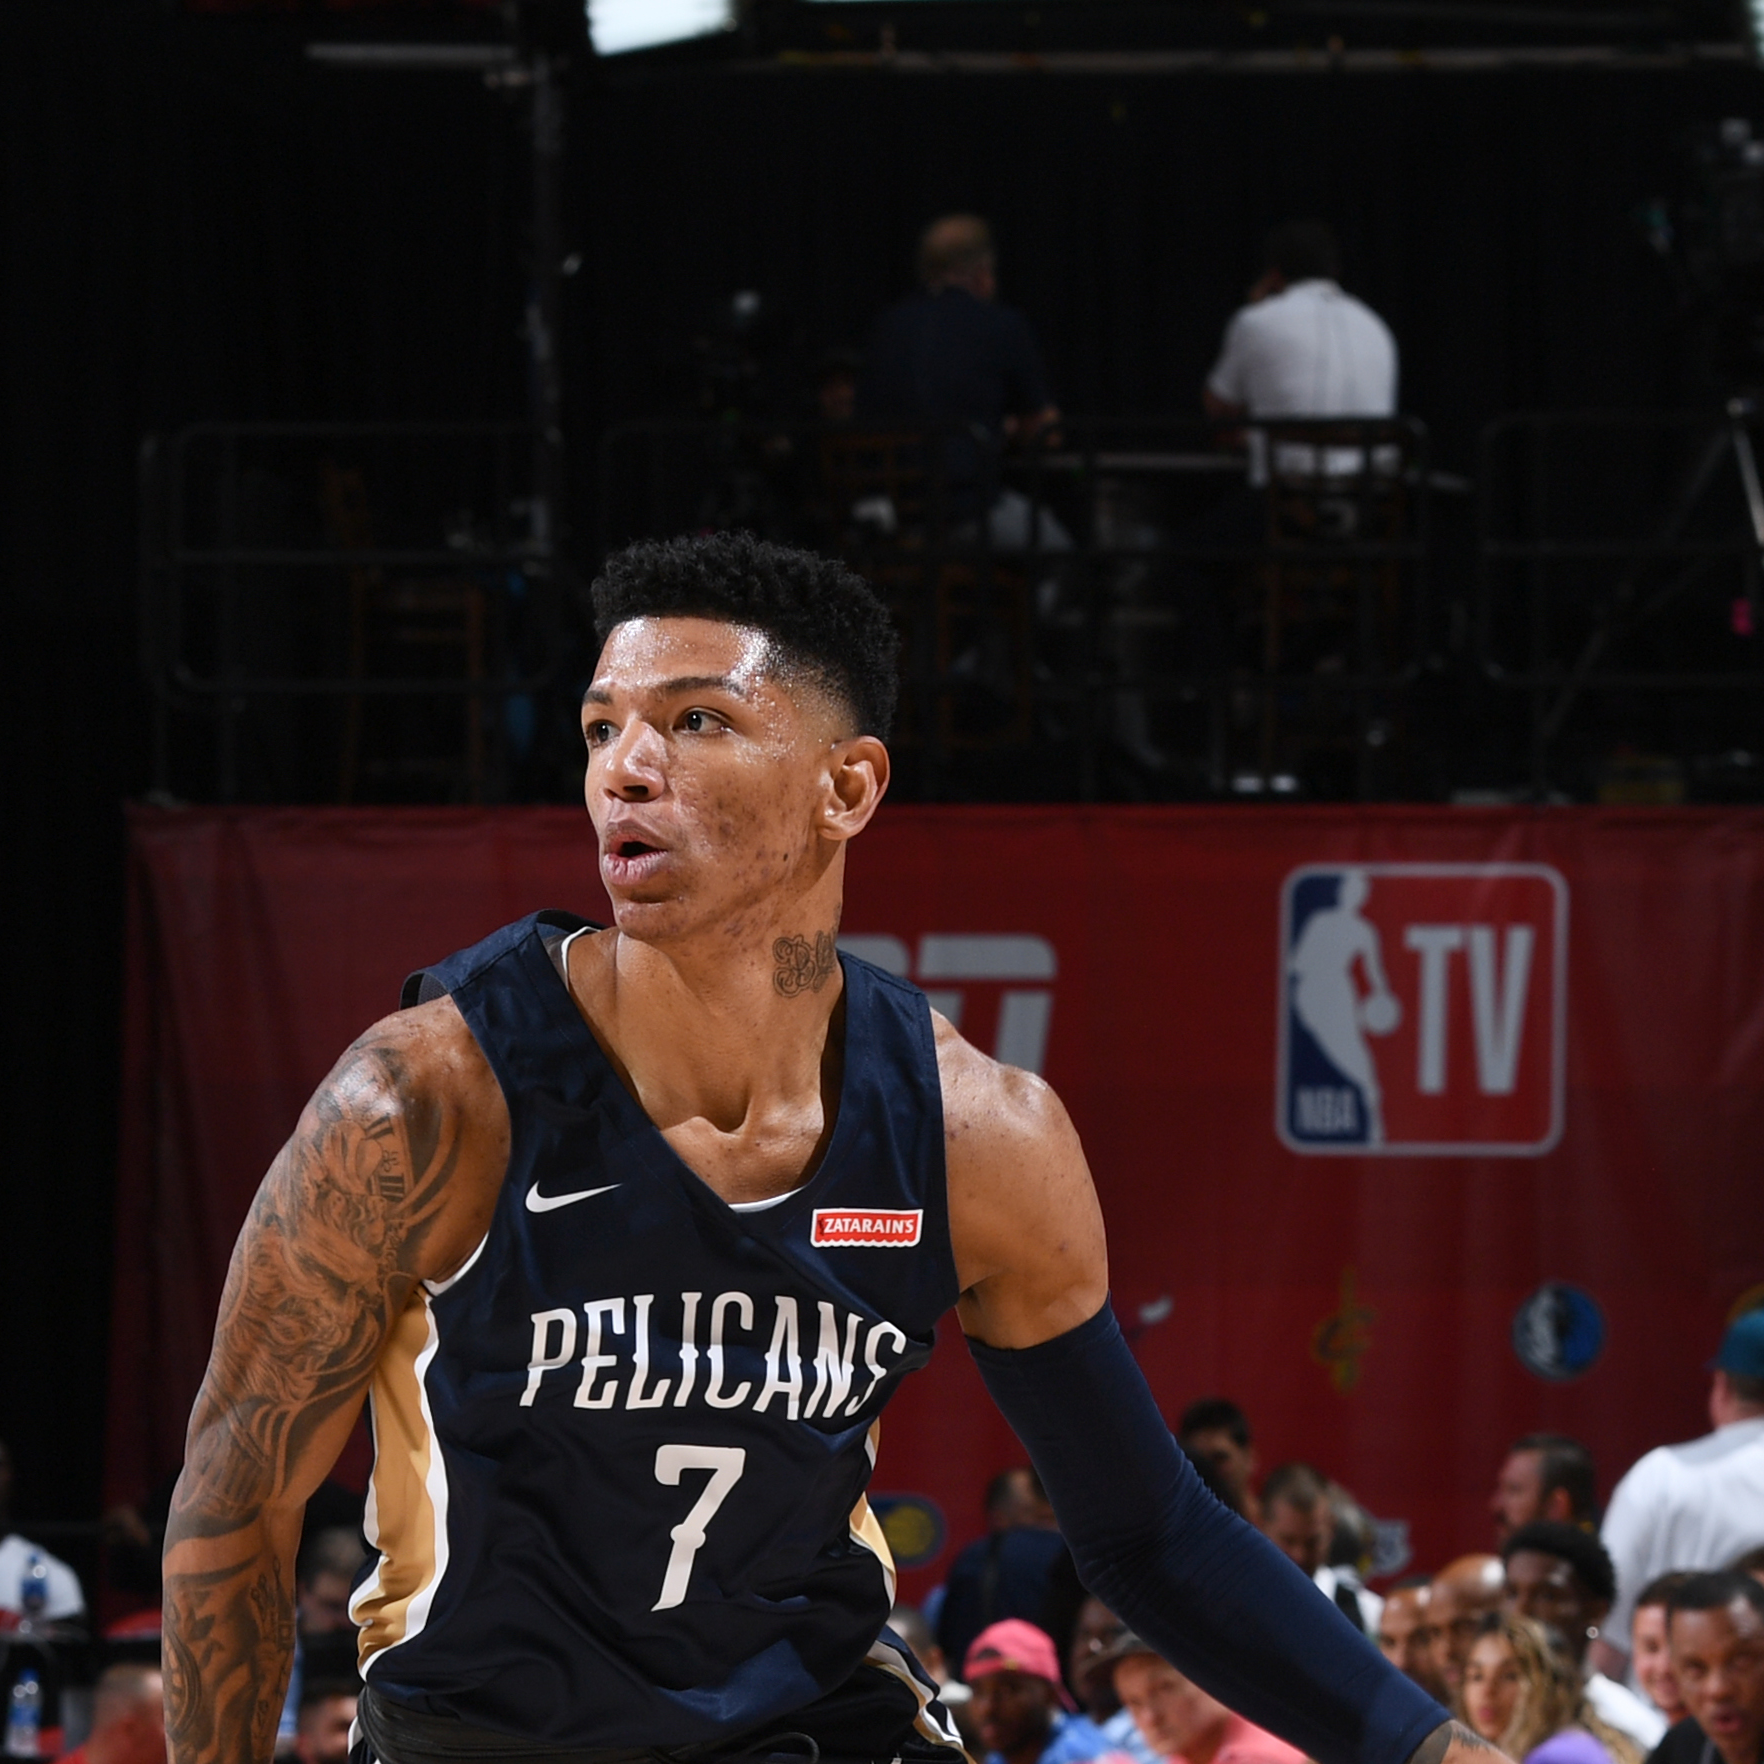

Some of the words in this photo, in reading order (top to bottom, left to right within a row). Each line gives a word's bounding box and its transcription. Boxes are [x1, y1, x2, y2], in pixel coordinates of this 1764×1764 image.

[1404, 924, 1533, 1094] TV
[1298, 1087, 1359, 1135] NBA
[519, 1291, 907, 1421] PELICANS
[650, 1443, 747, 1613] 7
